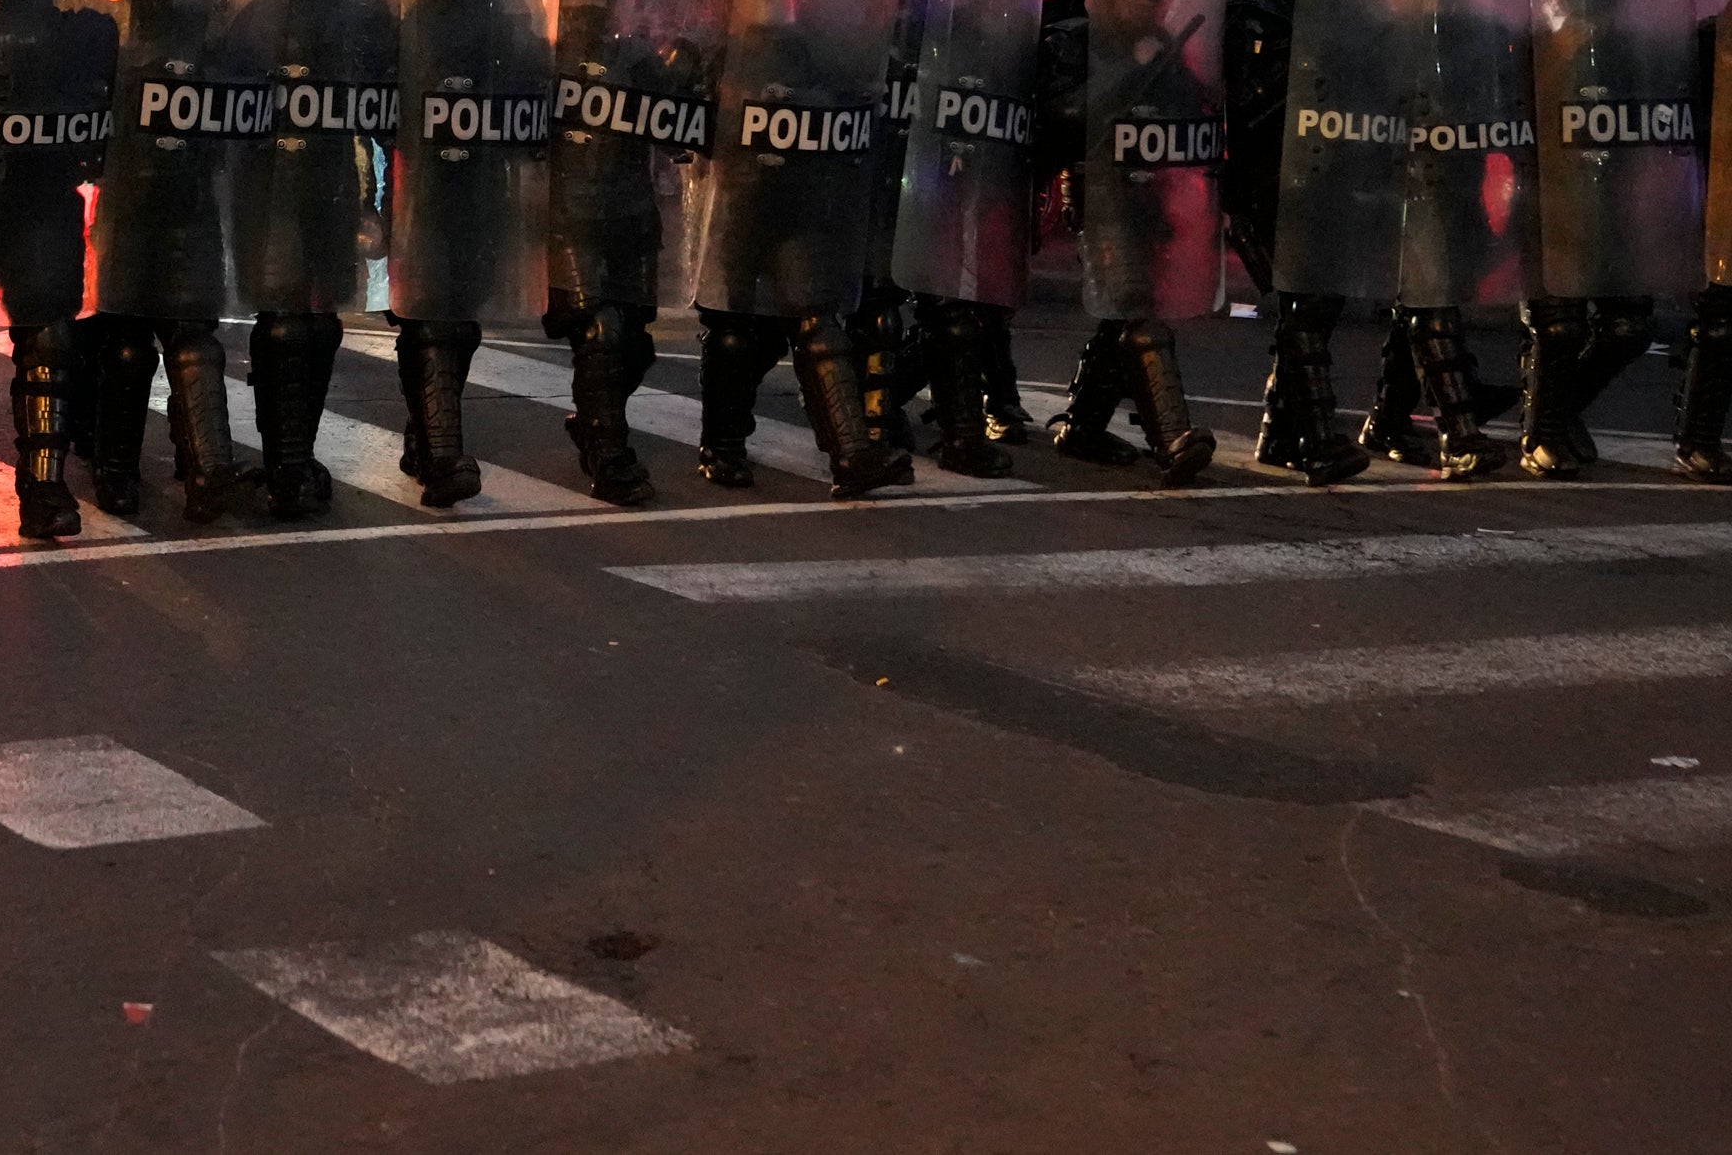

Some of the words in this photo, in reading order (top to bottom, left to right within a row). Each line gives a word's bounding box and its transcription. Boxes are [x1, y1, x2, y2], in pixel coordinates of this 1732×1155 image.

[140, 82, 273, 133] POLICIA
[423, 97, 549, 141] POLICIA
[553, 79, 706, 146] POLICIA
[741, 105, 870, 151] POLICIA
[1298, 109, 1406, 144] POLICIA
[1562, 102, 1695, 142] POLICIA
[1409, 120, 1535, 152] POLICIA
